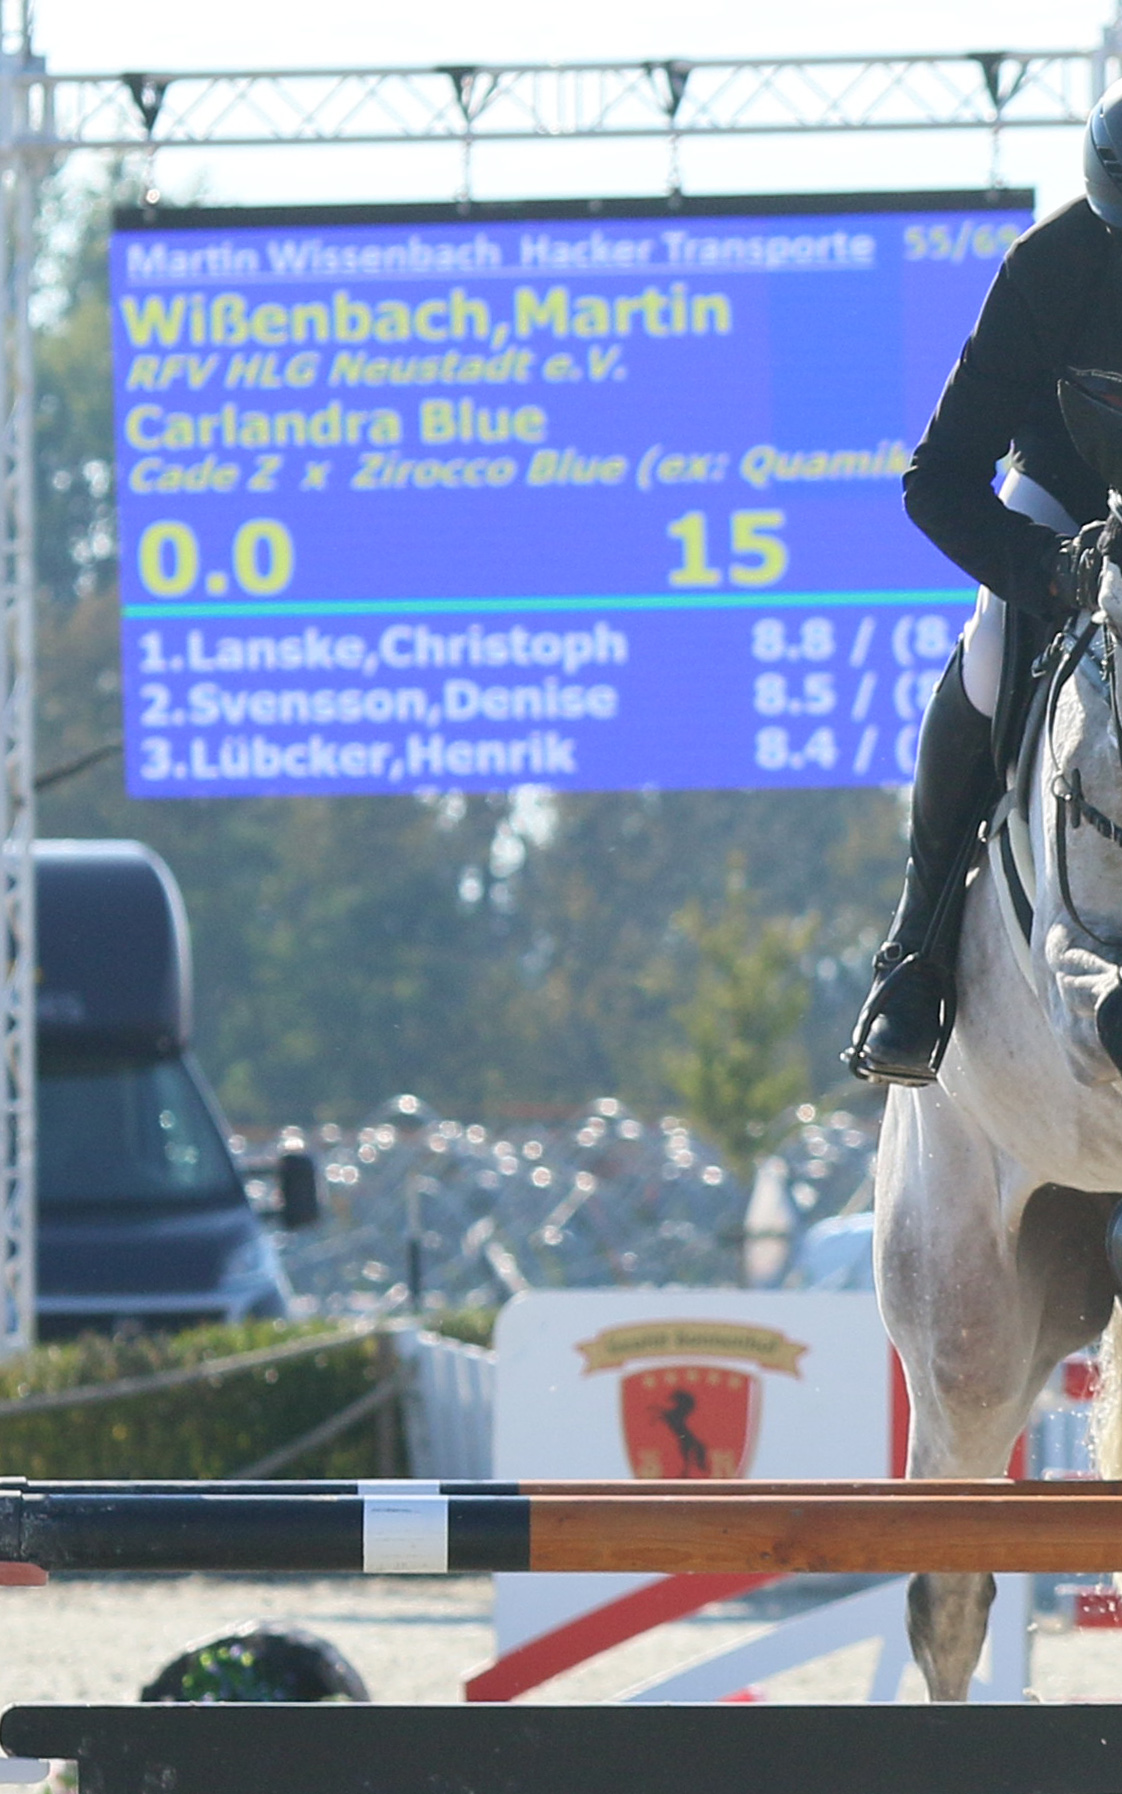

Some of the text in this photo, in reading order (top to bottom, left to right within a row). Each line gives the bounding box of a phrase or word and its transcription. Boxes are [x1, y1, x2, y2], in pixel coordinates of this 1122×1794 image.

[126, 228, 877, 277] Martin Wissenbach Hacker Transporte
[121, 282, 732, 350] Wißenbach,Martin
[126, 344, 628, 391] RFV HLG Neustadt e.V.
[124, 396, 547, 450] Carlandra Blue
[129, 453, 240, 493] Cade
[247, 453, 283, 492] Z
[303, 460, 331, 490] x
[350, 450, 517, 491] Zirocco
[526, 445, 628, 486] Blue
[636, 443, 730, 491] (ex:
[138, 518, 294, 596] 0.0
[667, 508, 787, 587] 15
[138, 620, 629, 677] 1.Lanske,Christoph
[751, 616, 835, 662] 8.8
[850, 615, 875, 667] /
[139, 675, 619, 728] 2.Svensson,Denise
[753, 671, 837, 717] 8.5
[851, 671, 876, 722] /
[139, 730, 577, 782] 3.Lübcker,Henrik
[754, 725, 838, 771] 8.4
[853, 724, 878, 776] /
